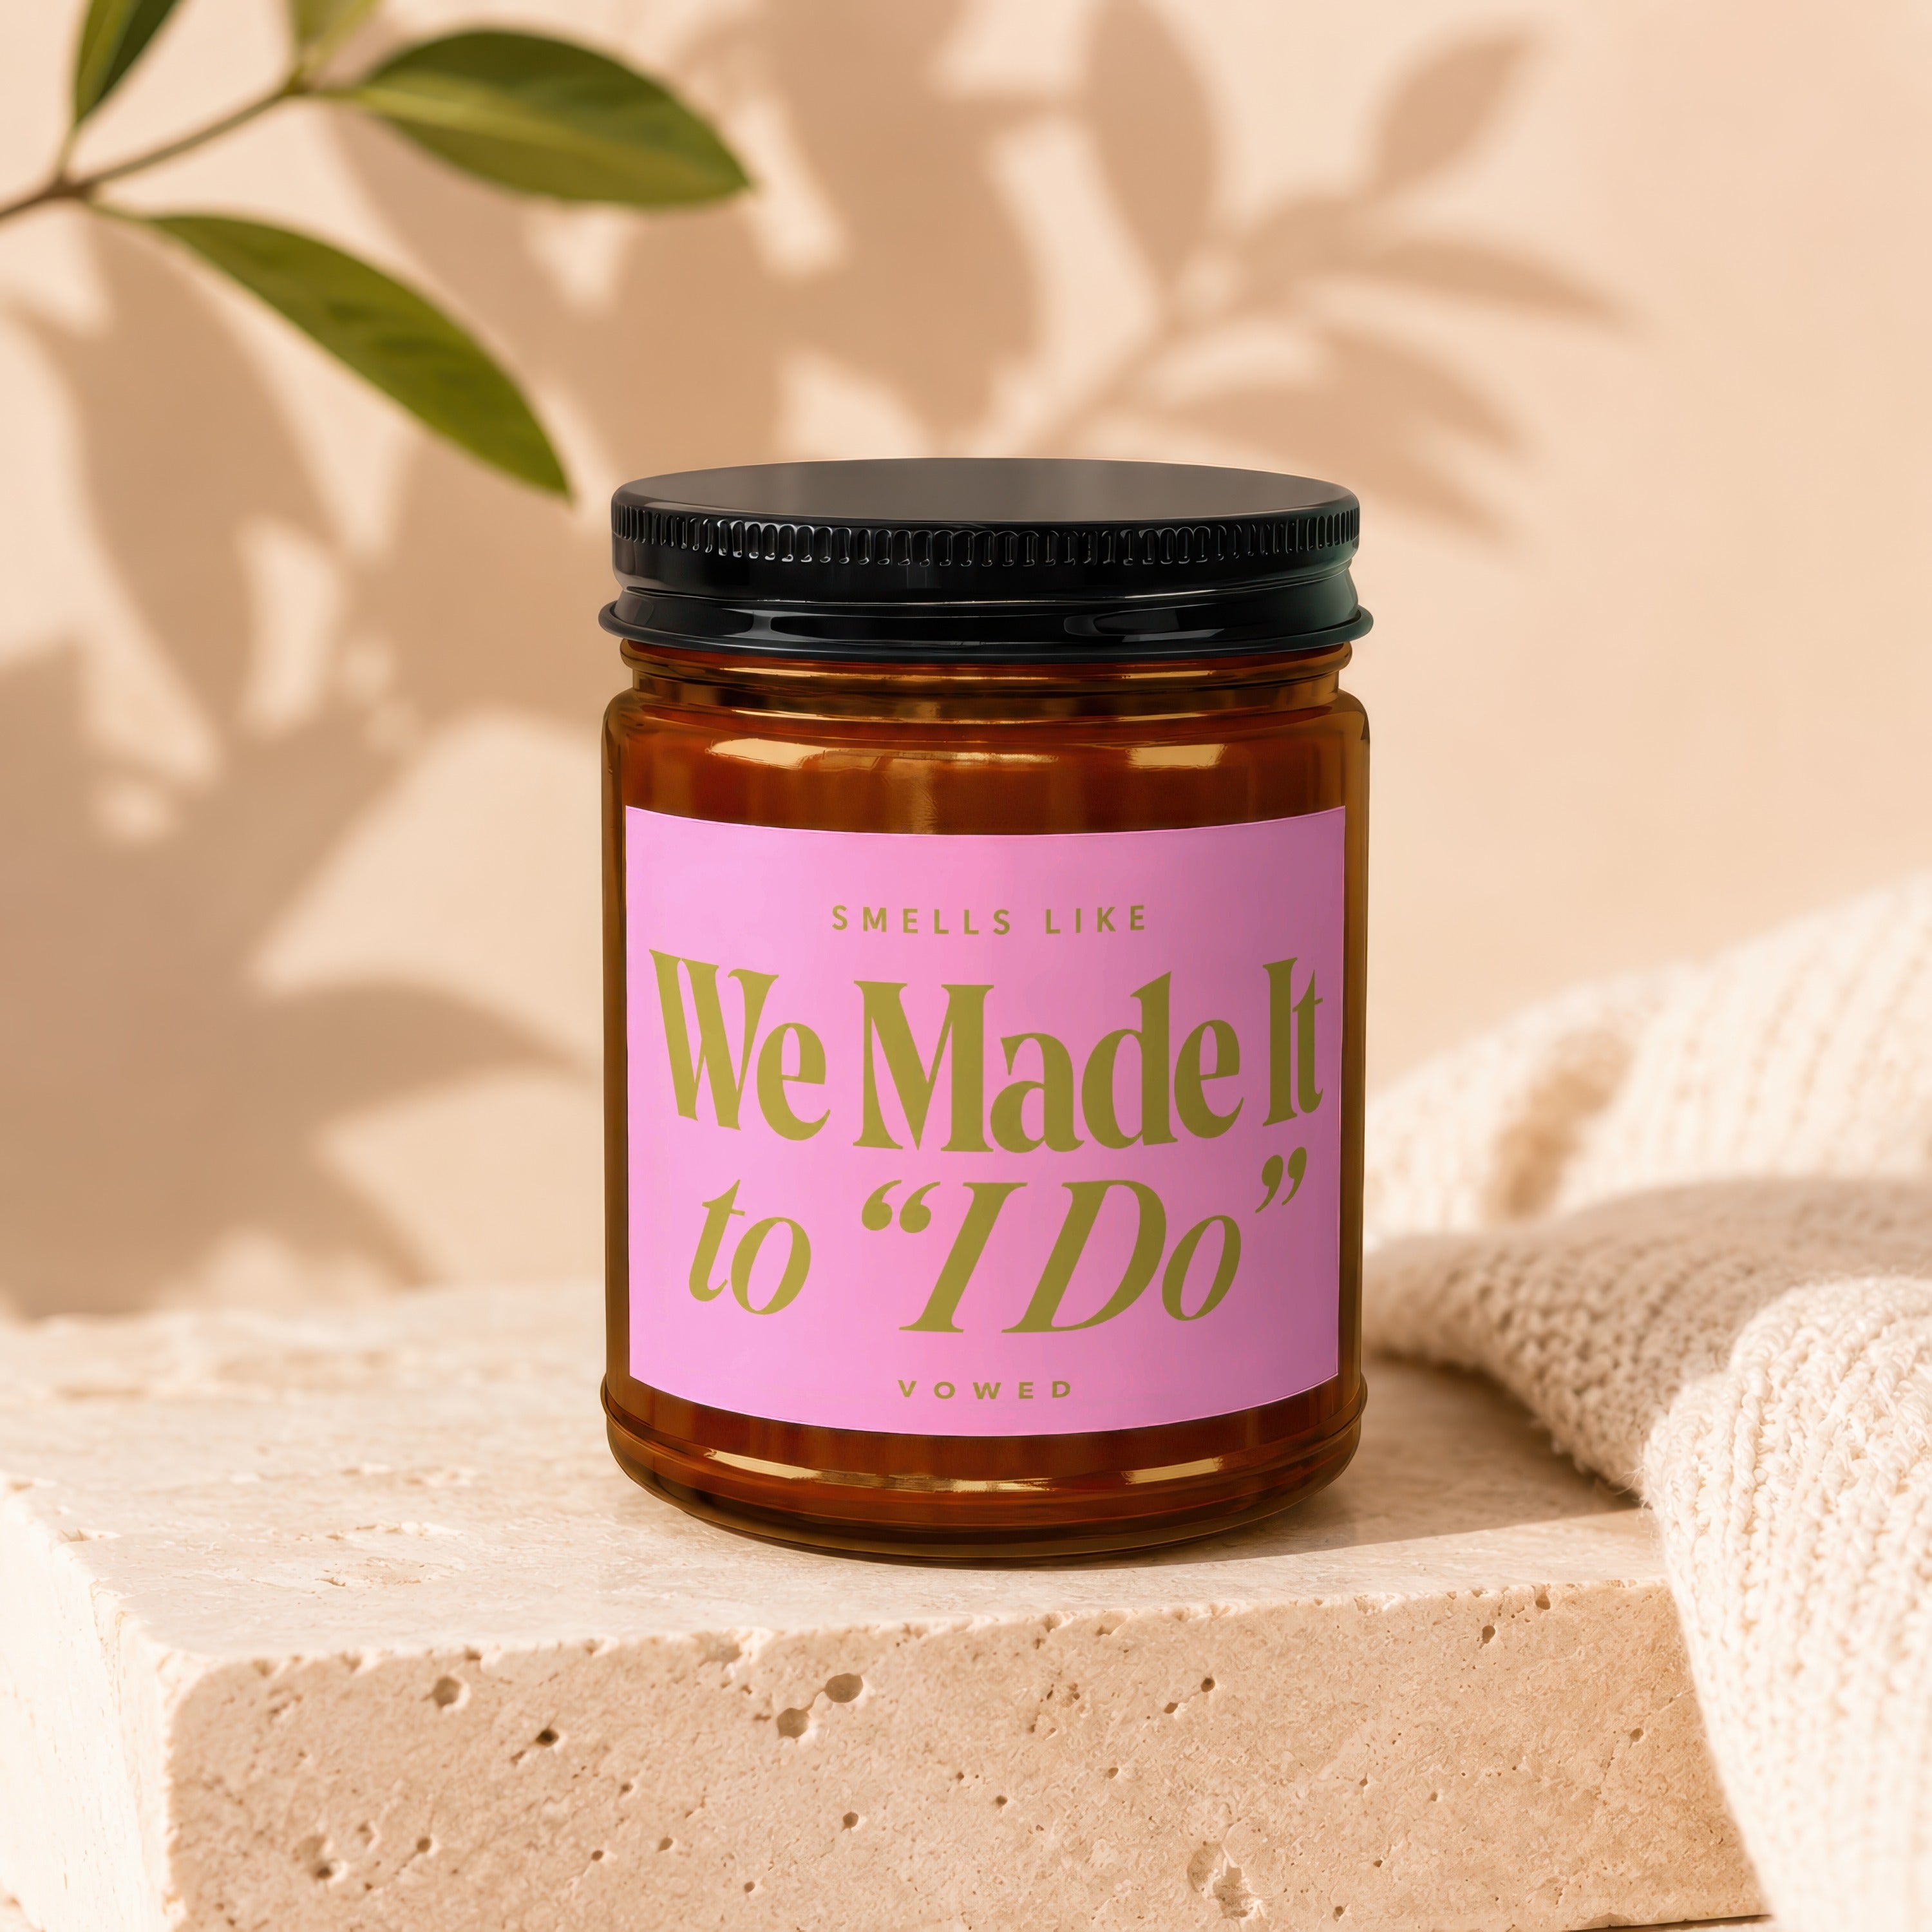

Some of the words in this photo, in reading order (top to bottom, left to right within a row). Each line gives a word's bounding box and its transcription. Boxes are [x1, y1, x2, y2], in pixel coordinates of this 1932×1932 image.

[831, 904, 1011, 936] SMELLS
[1045, 904, 1145, 935] LIKE
[648, 948, 831, 1142] We
[851, 970, 1245, 1155] Made
[1262, 956, 1324, 1128] It
[688, 1179, 812, 1316] to
[897, 1379, 1072, 1400] VOWED
